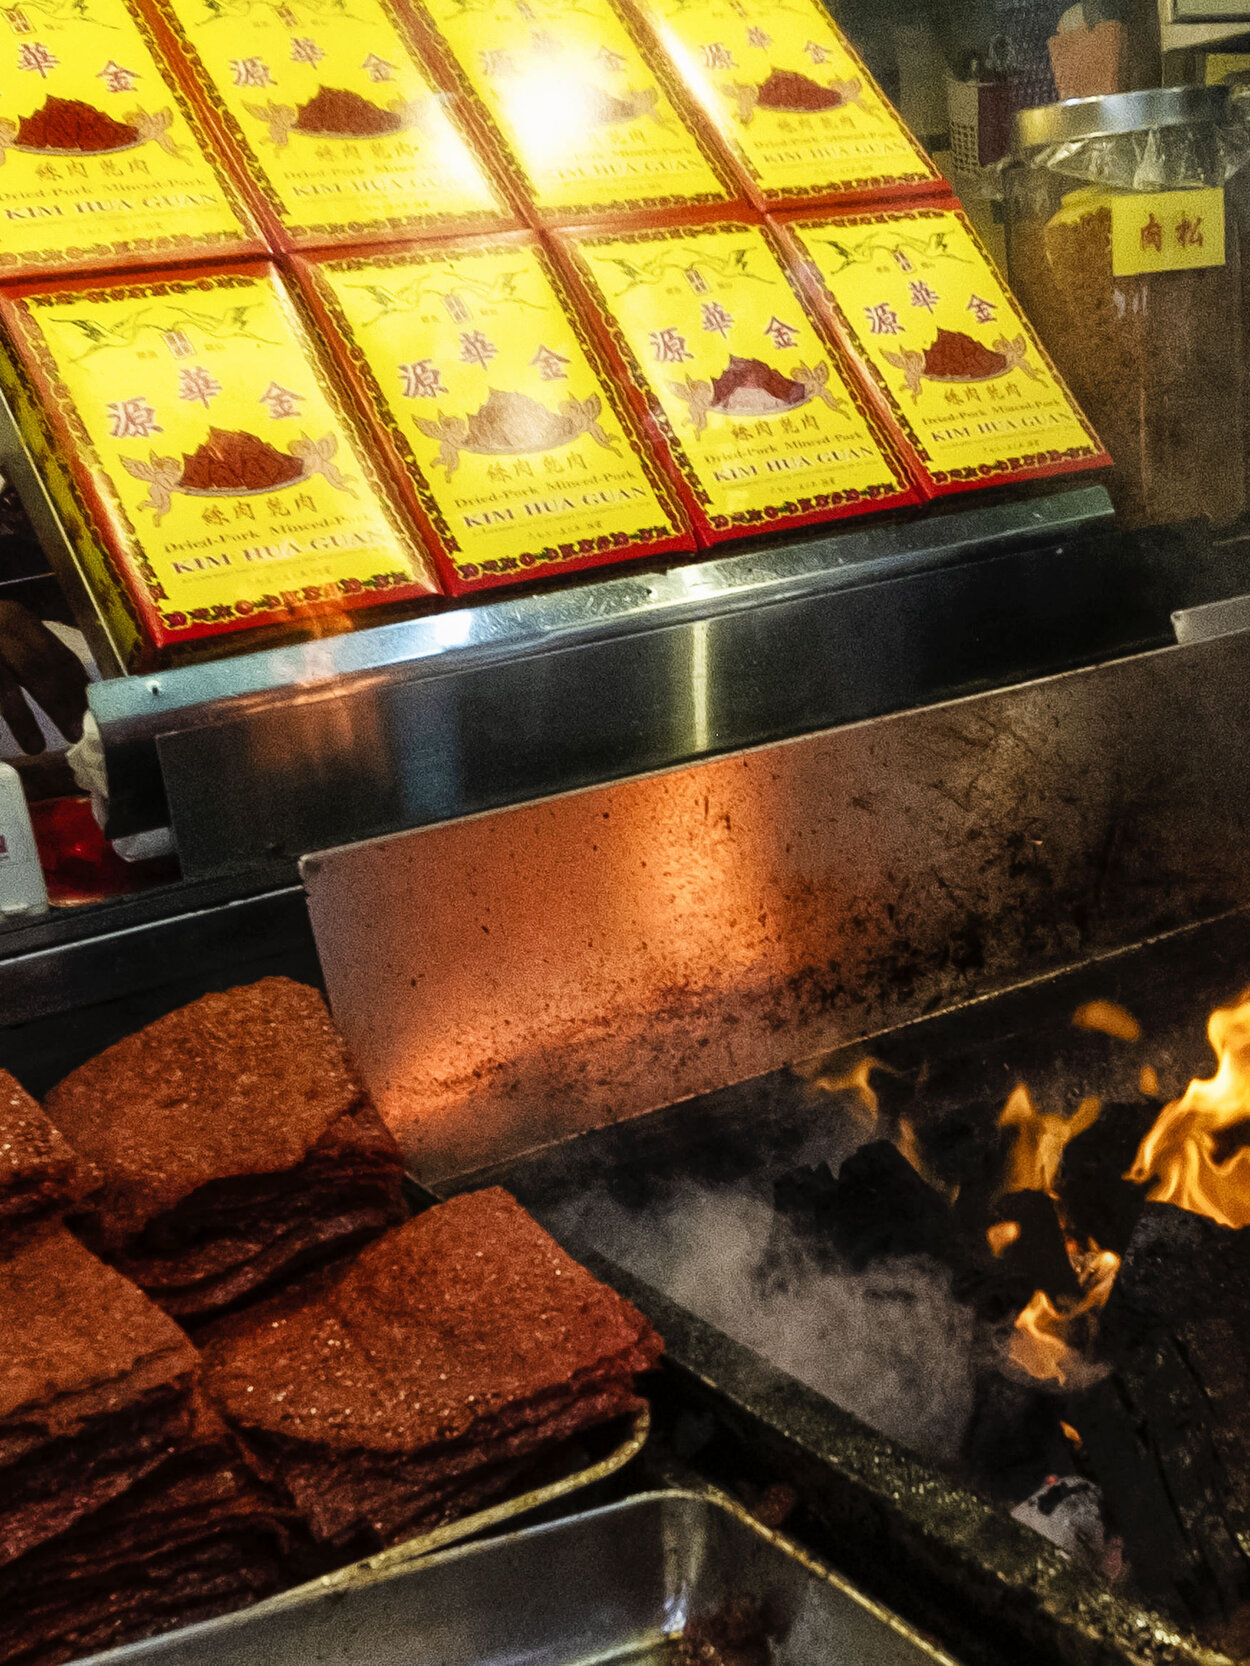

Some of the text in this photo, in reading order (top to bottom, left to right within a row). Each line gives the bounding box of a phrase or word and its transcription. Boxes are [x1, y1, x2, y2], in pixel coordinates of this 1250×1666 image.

[763, 151, 803, 164] KIM
[292, 183, 342, 196] KIM
[5, 204, 64, 220] KIM
[74, 198, 133, 214] HUA
[142, 193, 219, 208] GUAN
[930, 427, 971, 442] KIM
[977, 419, 1018, 435] HUA
[1021, 412, 1073, 428] GUAN
[713, 465, 759, 483] KIM
[766, 455, 812, 473] HUA
[816, 446, 875, 465] GUAN
[462, 508, 515, 529] KIM
[524, 497, 576, 516] HUA
[582, 486, 647, 506] GUAN
[172, 552, 232, 575] KIM
[242, 542, 303, 562] HUA
[308, 529, 386, 551] GUAN
